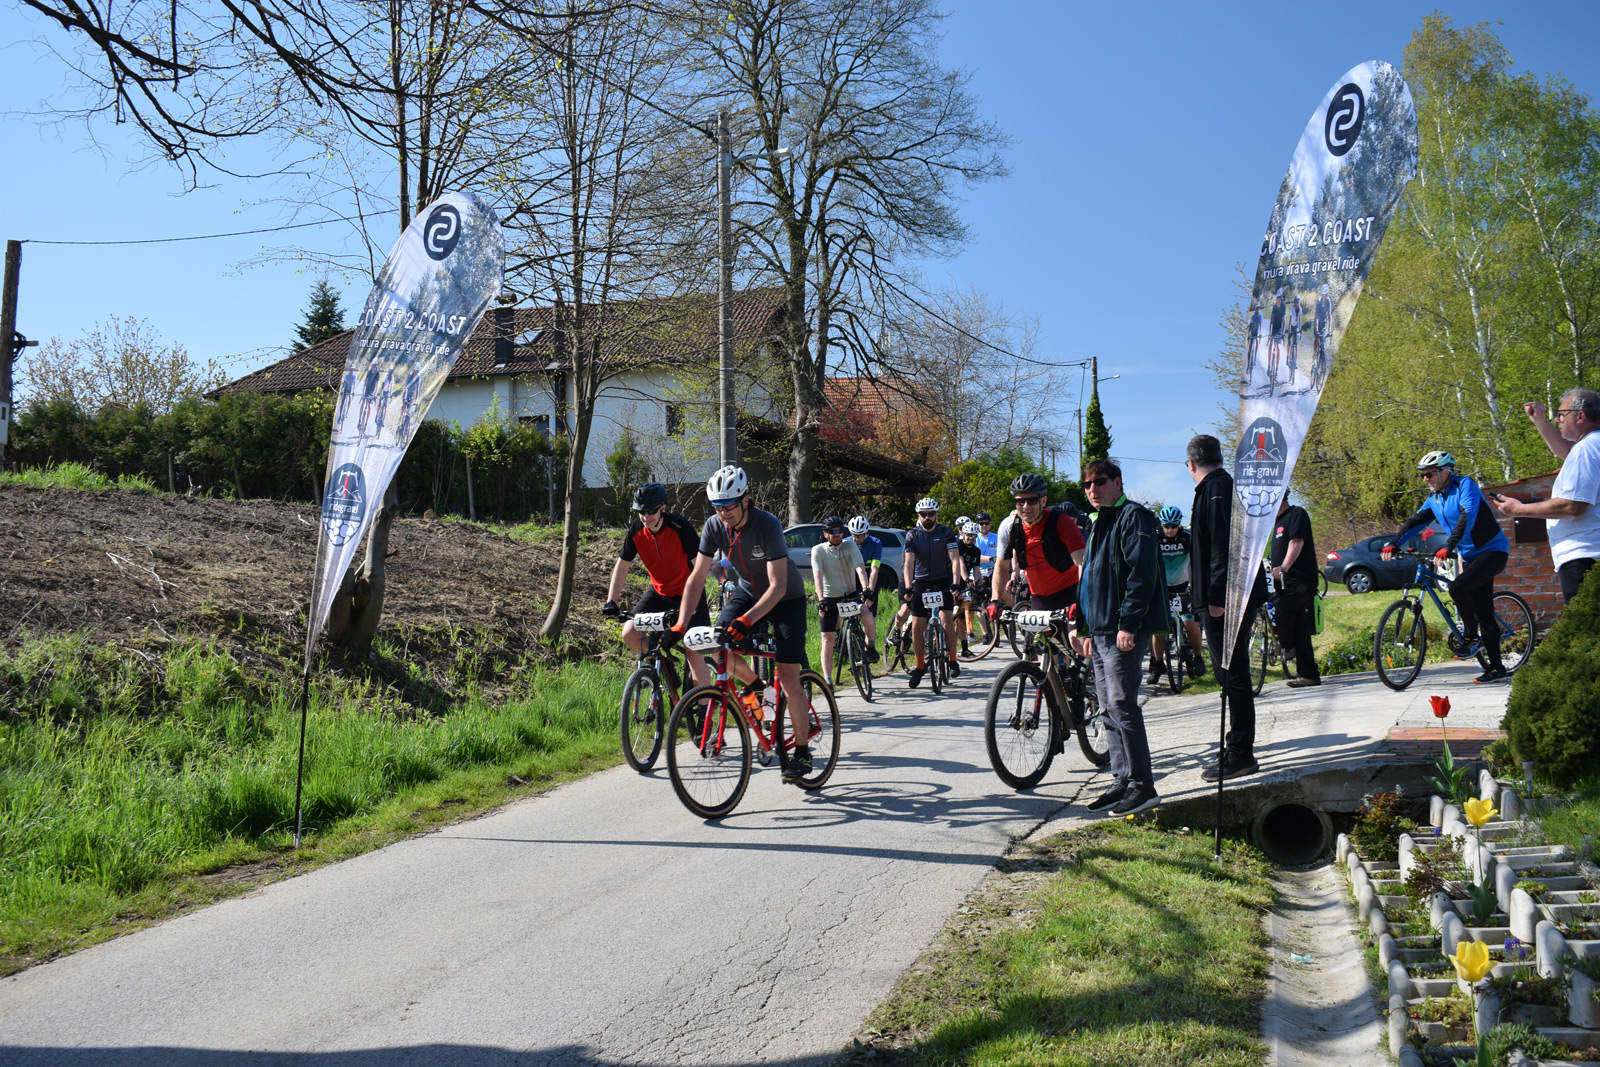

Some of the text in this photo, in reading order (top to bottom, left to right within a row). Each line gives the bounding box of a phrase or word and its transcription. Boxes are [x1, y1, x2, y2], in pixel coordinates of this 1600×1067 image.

[1308, 223, 1318, 247] 2
[1323, 216, 1375, 245] COAST
[1286, 261, 1310, 276] drava
[1312, 256, 1341, 277] gravel
[1342, 255, 1360, 271] ride
[404, 310, 415, 330] 2
[418, 311, 467, 335] COAST
[381, 338, 405, 350] drava
[406, 341, 434, 354] gravel
[923, 594, 942, 605] 116
[1168, 599, 1180, 607] 32
[839, 604, 858, 613] 113
[635, 615, 661, 627] 125
[1020, 614, 1047, 627] 101
[686, 631, 713, 647] 135
